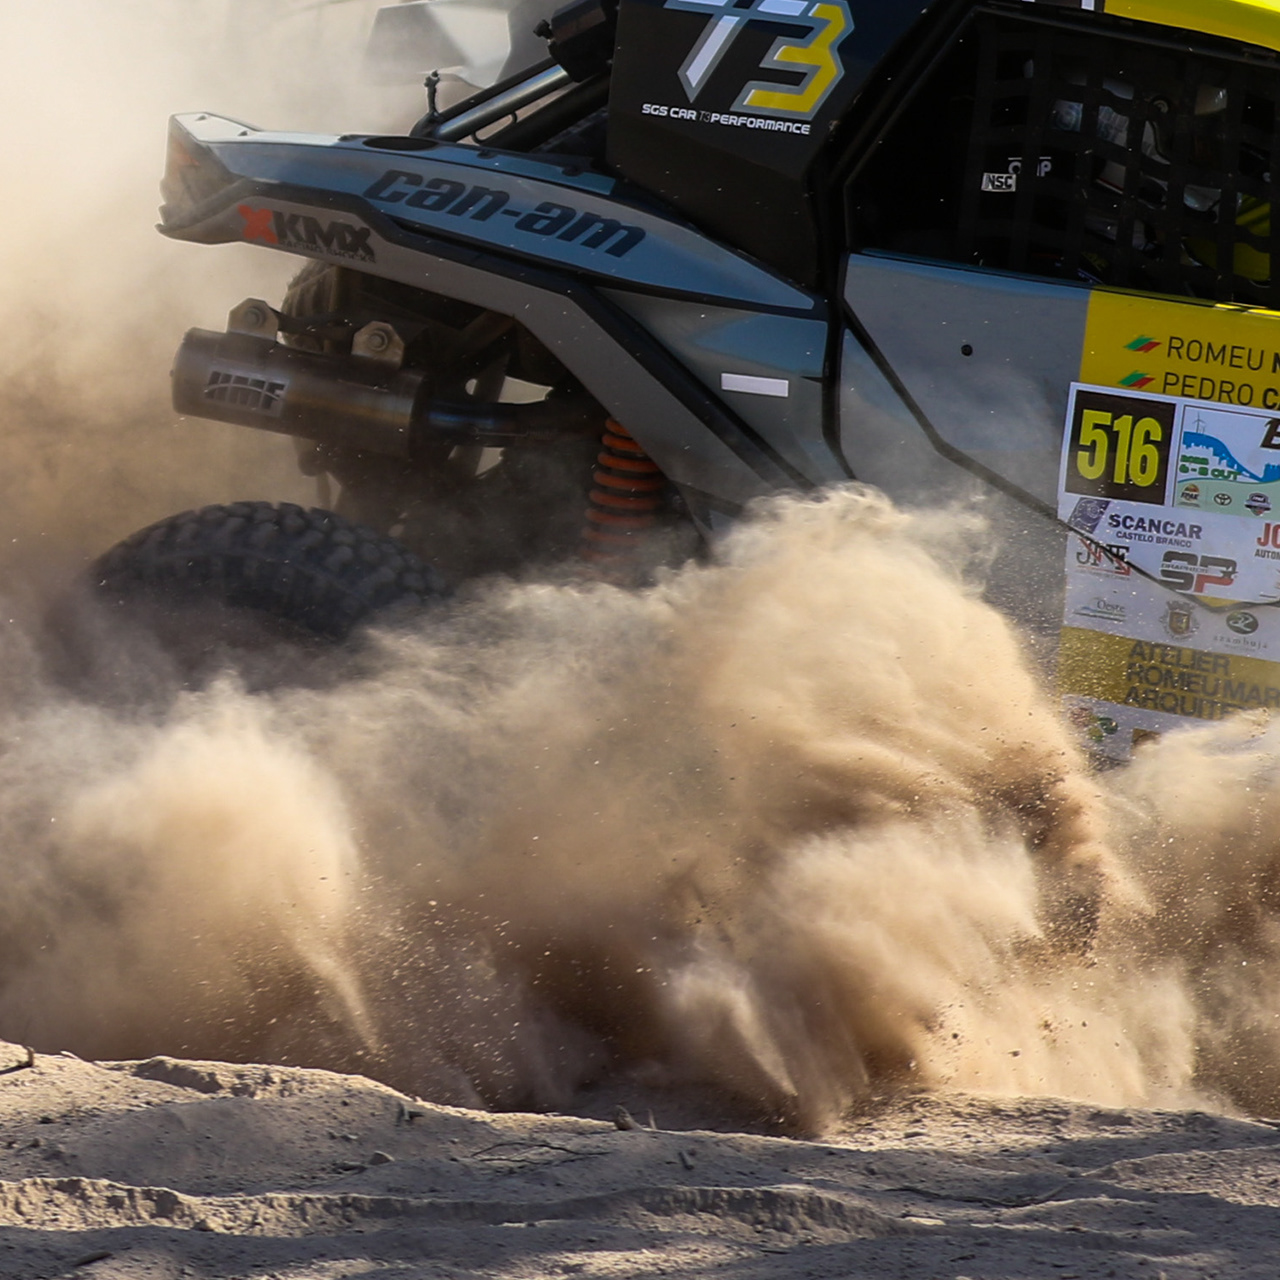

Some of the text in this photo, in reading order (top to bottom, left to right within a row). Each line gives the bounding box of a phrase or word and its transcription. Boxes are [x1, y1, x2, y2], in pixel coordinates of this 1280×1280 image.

[642, 103, 668, 117] SGS
[670, 107, 696, 120] CAR
[711, 112, 811, 135] PERFORMANCE
[363, 170, 646, 258] can-am
[1167, 336, 1264, 370] ROMEU
[1163, 372, 1253, 406] PEDRO
[1076, 409, 1162, 487] 516
[1107, 513, 1203, 540] SCANCAR
[1116, 530, 1192, 549] CASTELO BRANCO
[1129, 640, 1231, 676] ATELIER
[1125, 663, 1220, 697] ROMEU
